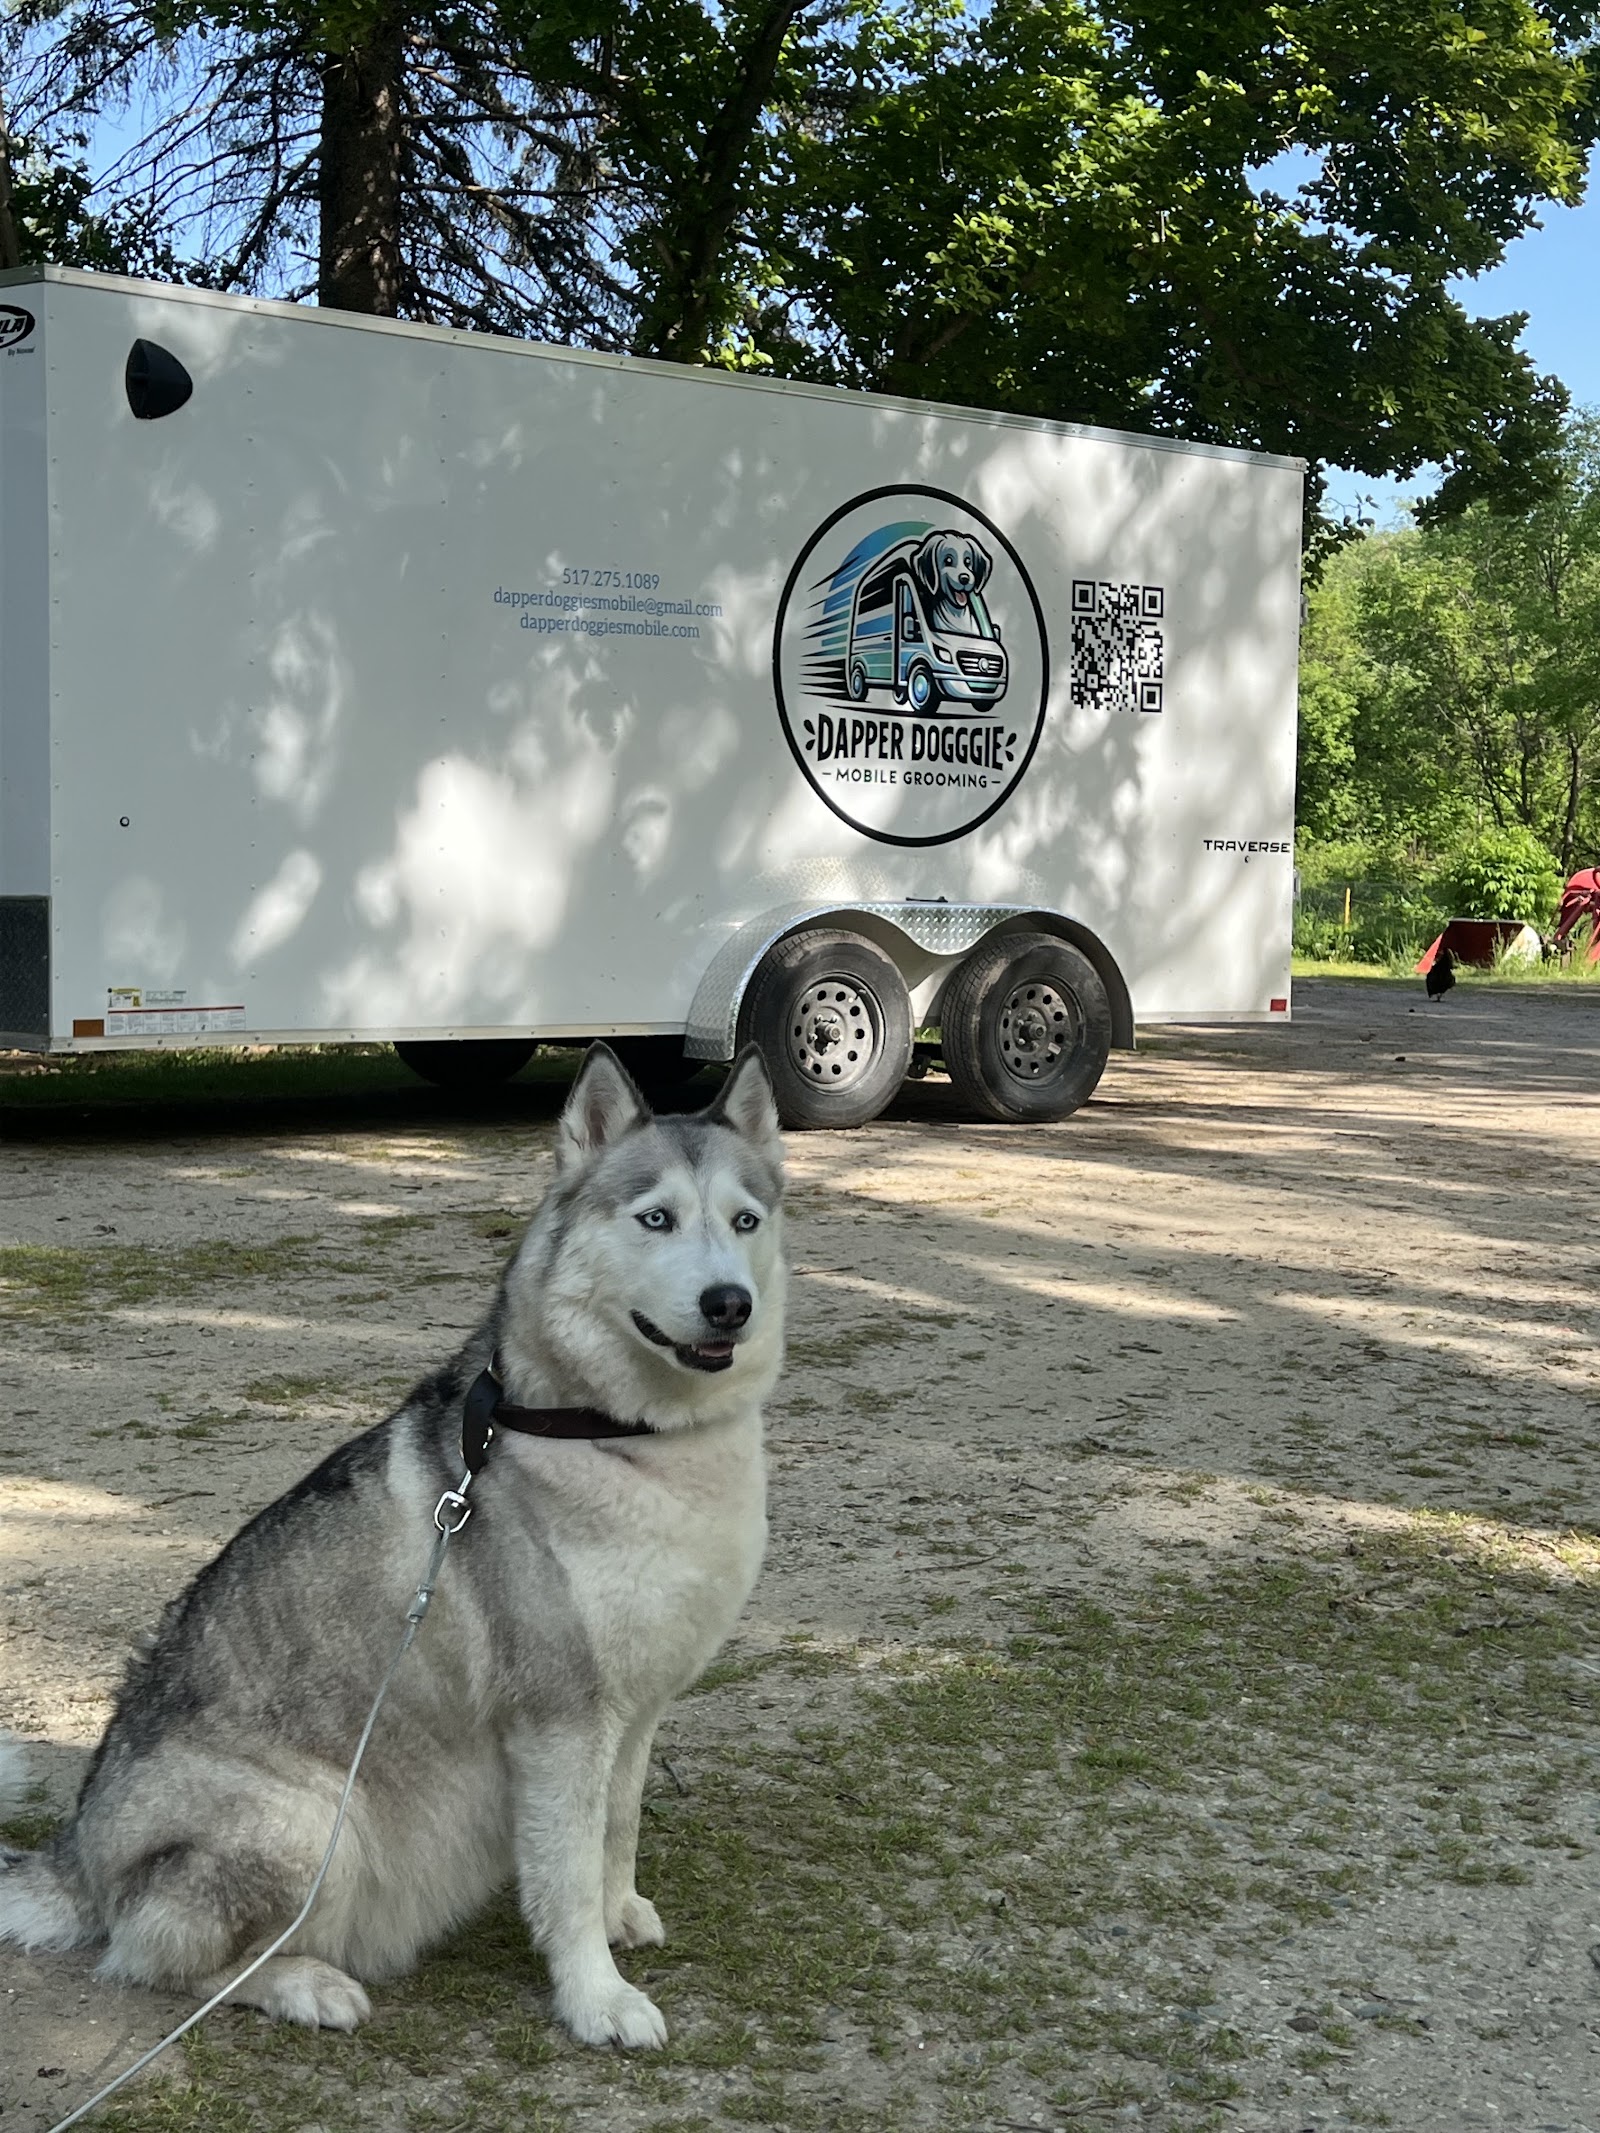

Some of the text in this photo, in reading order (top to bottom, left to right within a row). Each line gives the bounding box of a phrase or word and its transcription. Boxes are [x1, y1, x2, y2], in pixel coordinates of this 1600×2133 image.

[563, 568, 660, 590] 517.275.1089
[494, 587, 723, 617] dapperdoggiesmobile@gmail.com
[520, 613, 700, 638] dapperdoggiesmobile.com
[817, 713, 1004, 771] DAPPER DOGGGIE
[835, 768, 987, 788] MOBILE GROOMING
[1203, 840, 1290, 853] TRAVERSE
